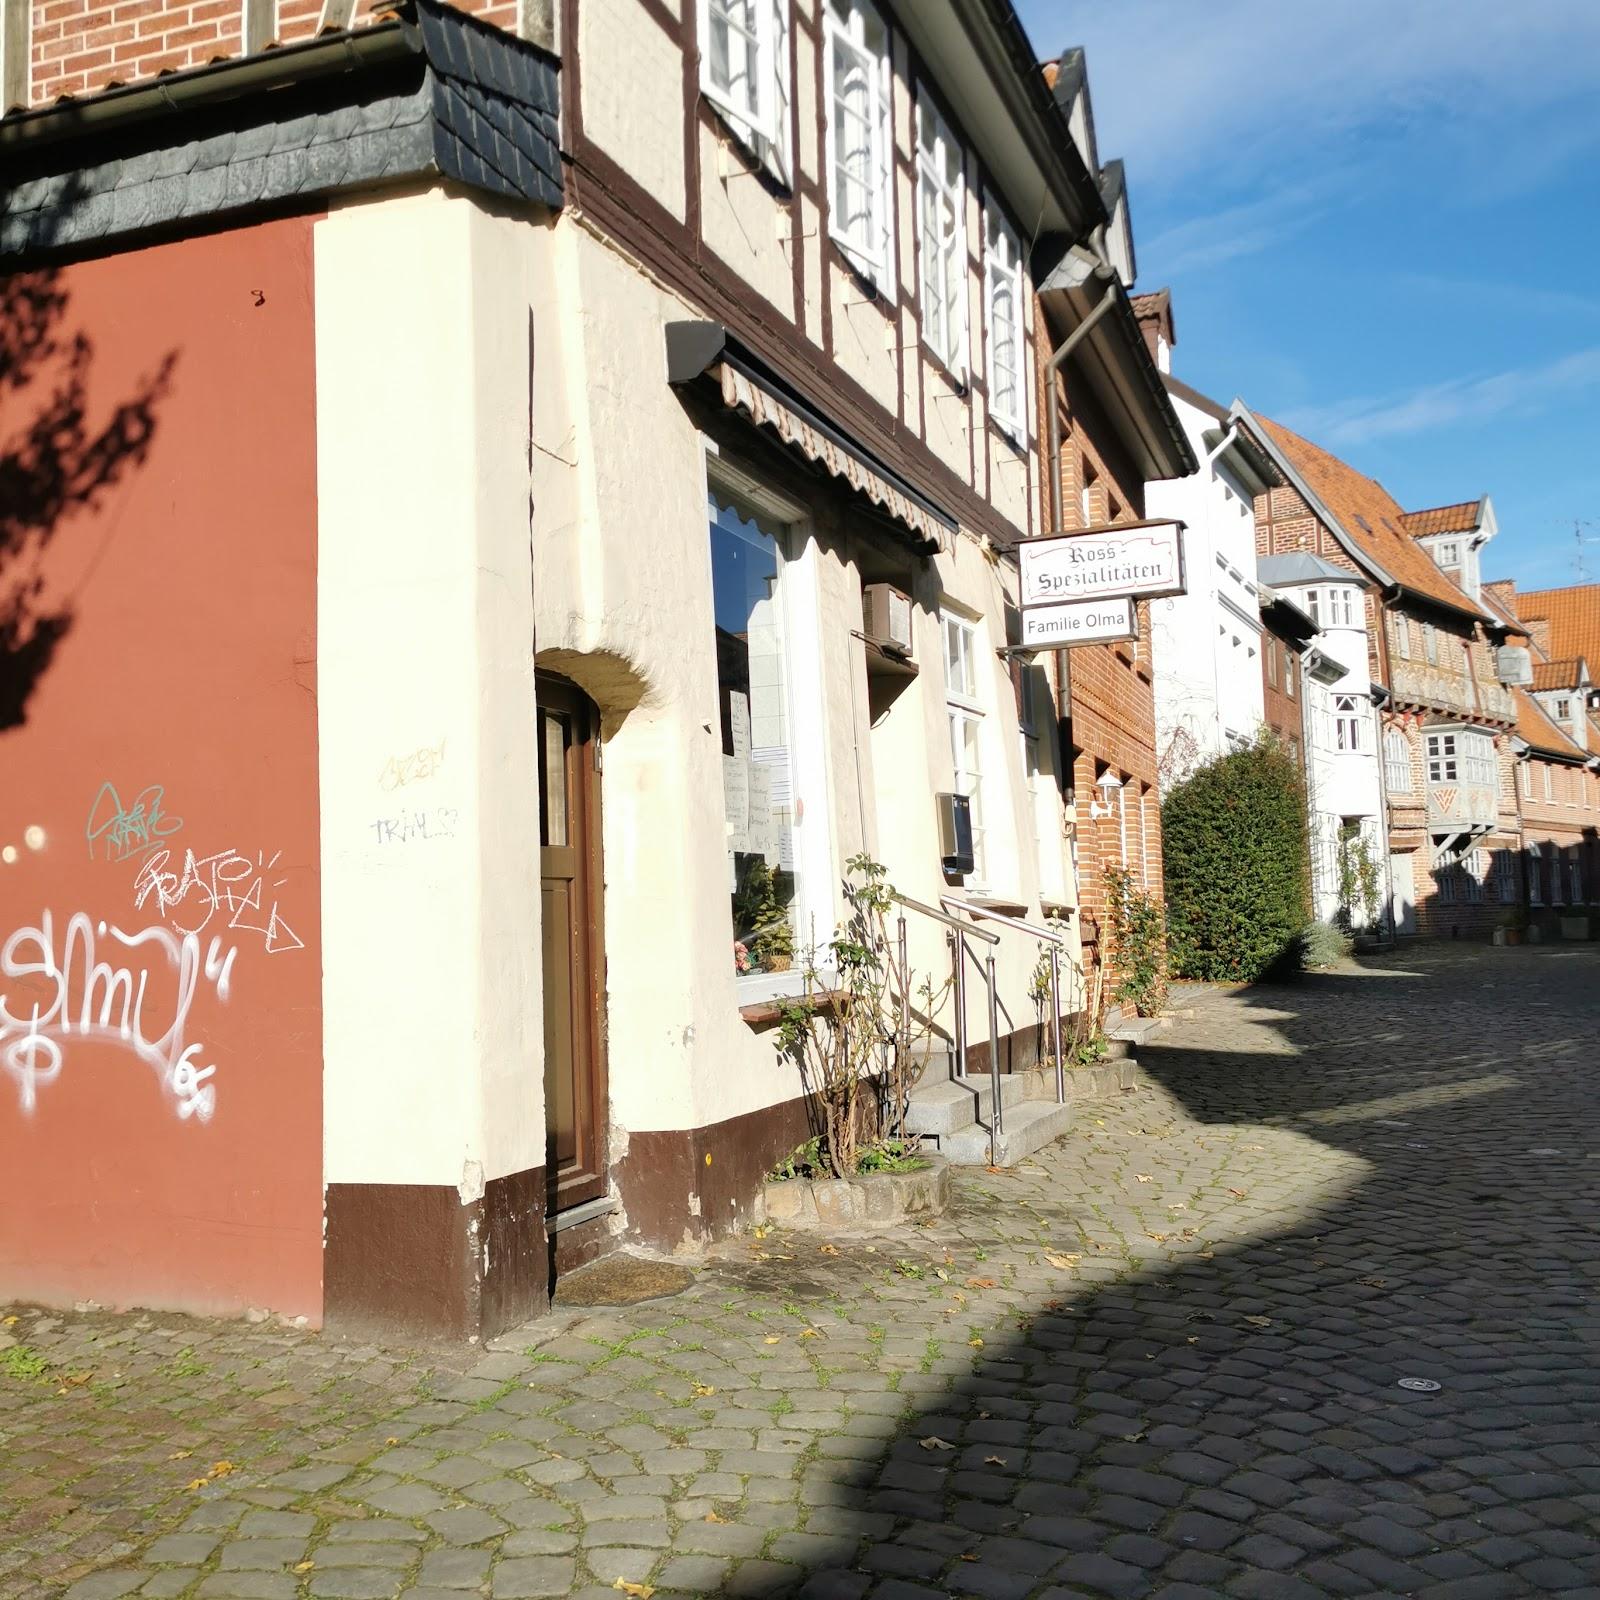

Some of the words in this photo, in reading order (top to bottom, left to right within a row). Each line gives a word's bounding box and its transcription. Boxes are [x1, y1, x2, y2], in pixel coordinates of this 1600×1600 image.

[1038, 562, 1162, 591] Spezialitäten
[1028, 616, 1081, 634] Familie
[1085, 613, 1125, 628] Olma
